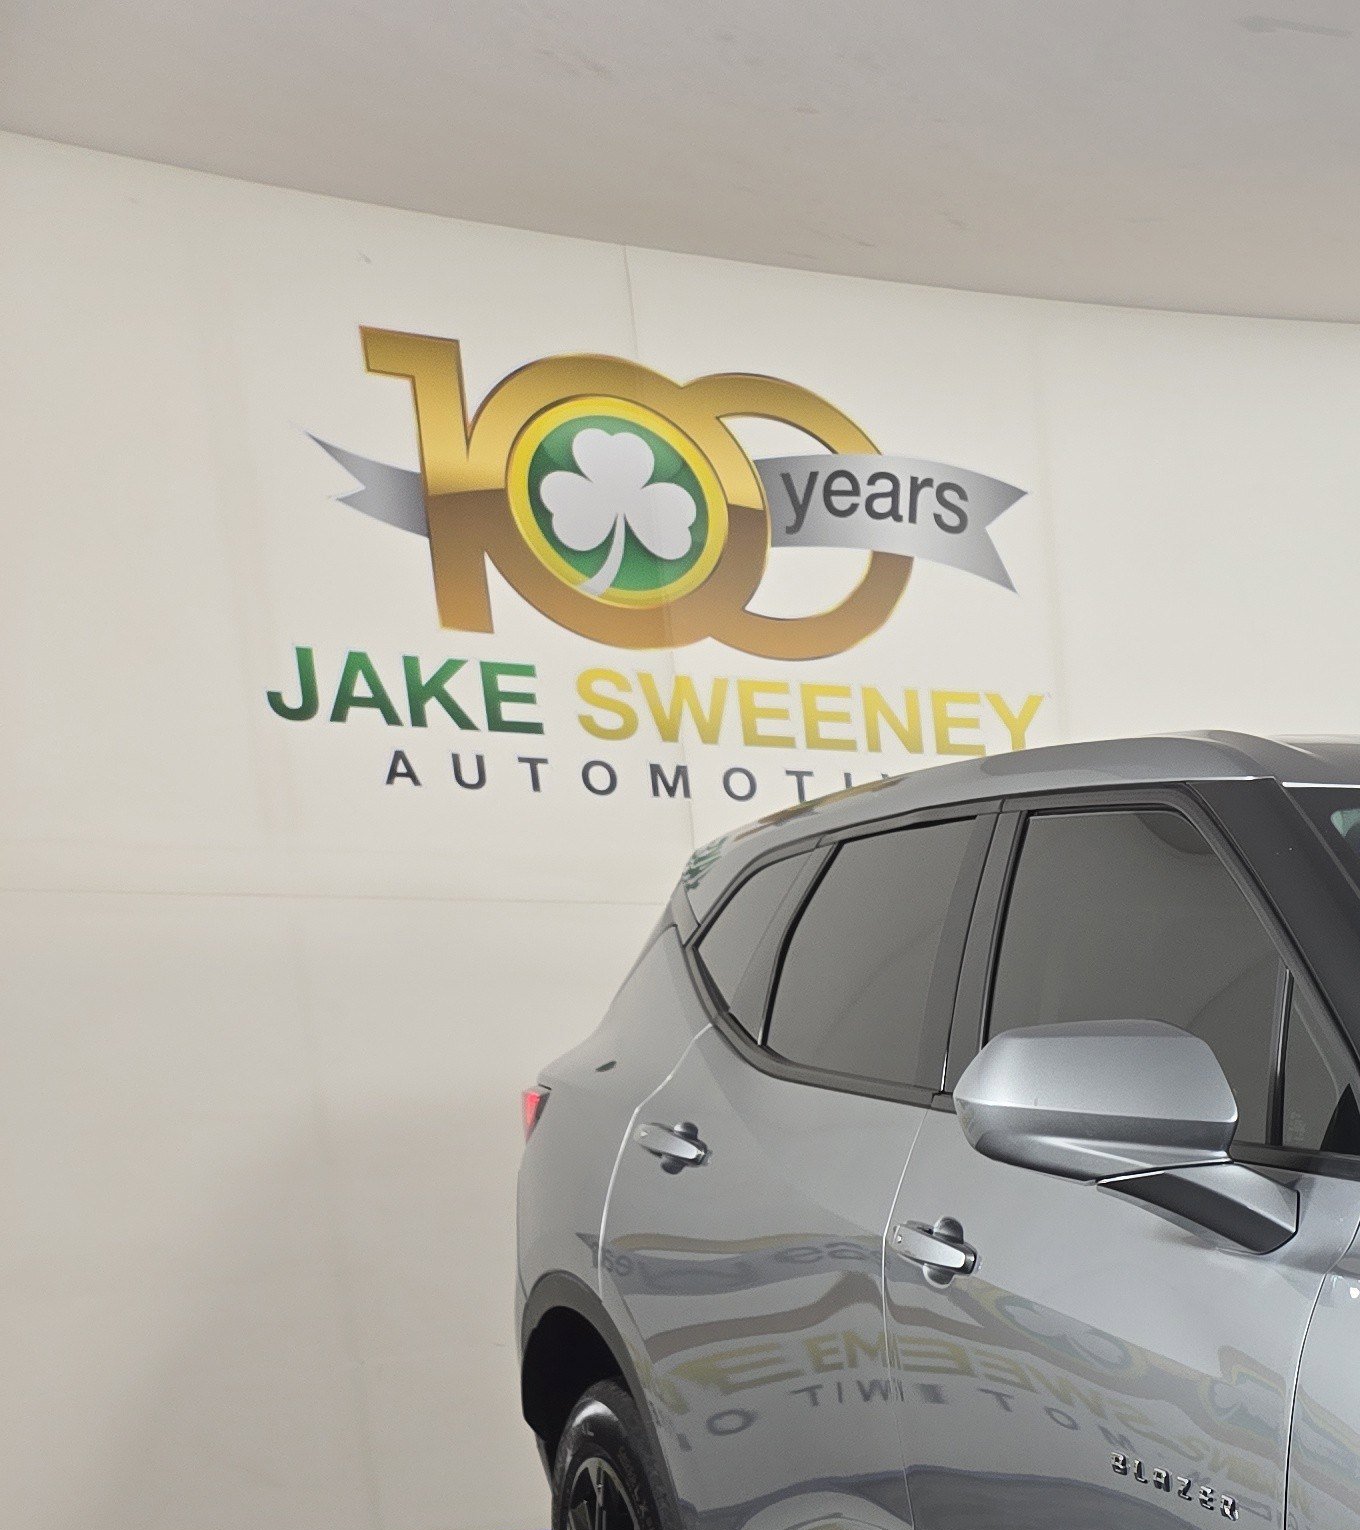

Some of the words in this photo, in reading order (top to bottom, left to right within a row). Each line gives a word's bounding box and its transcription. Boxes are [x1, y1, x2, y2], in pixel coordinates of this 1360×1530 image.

[782, 466, 970, 534] years
[266, 645, 545, 735] JAKE
[575, 668, 1044, 757] SWEENEY
[385, 750, 890, 802] AUTOMOT
[1110, 1451, 1239, 1522] BLAZER
